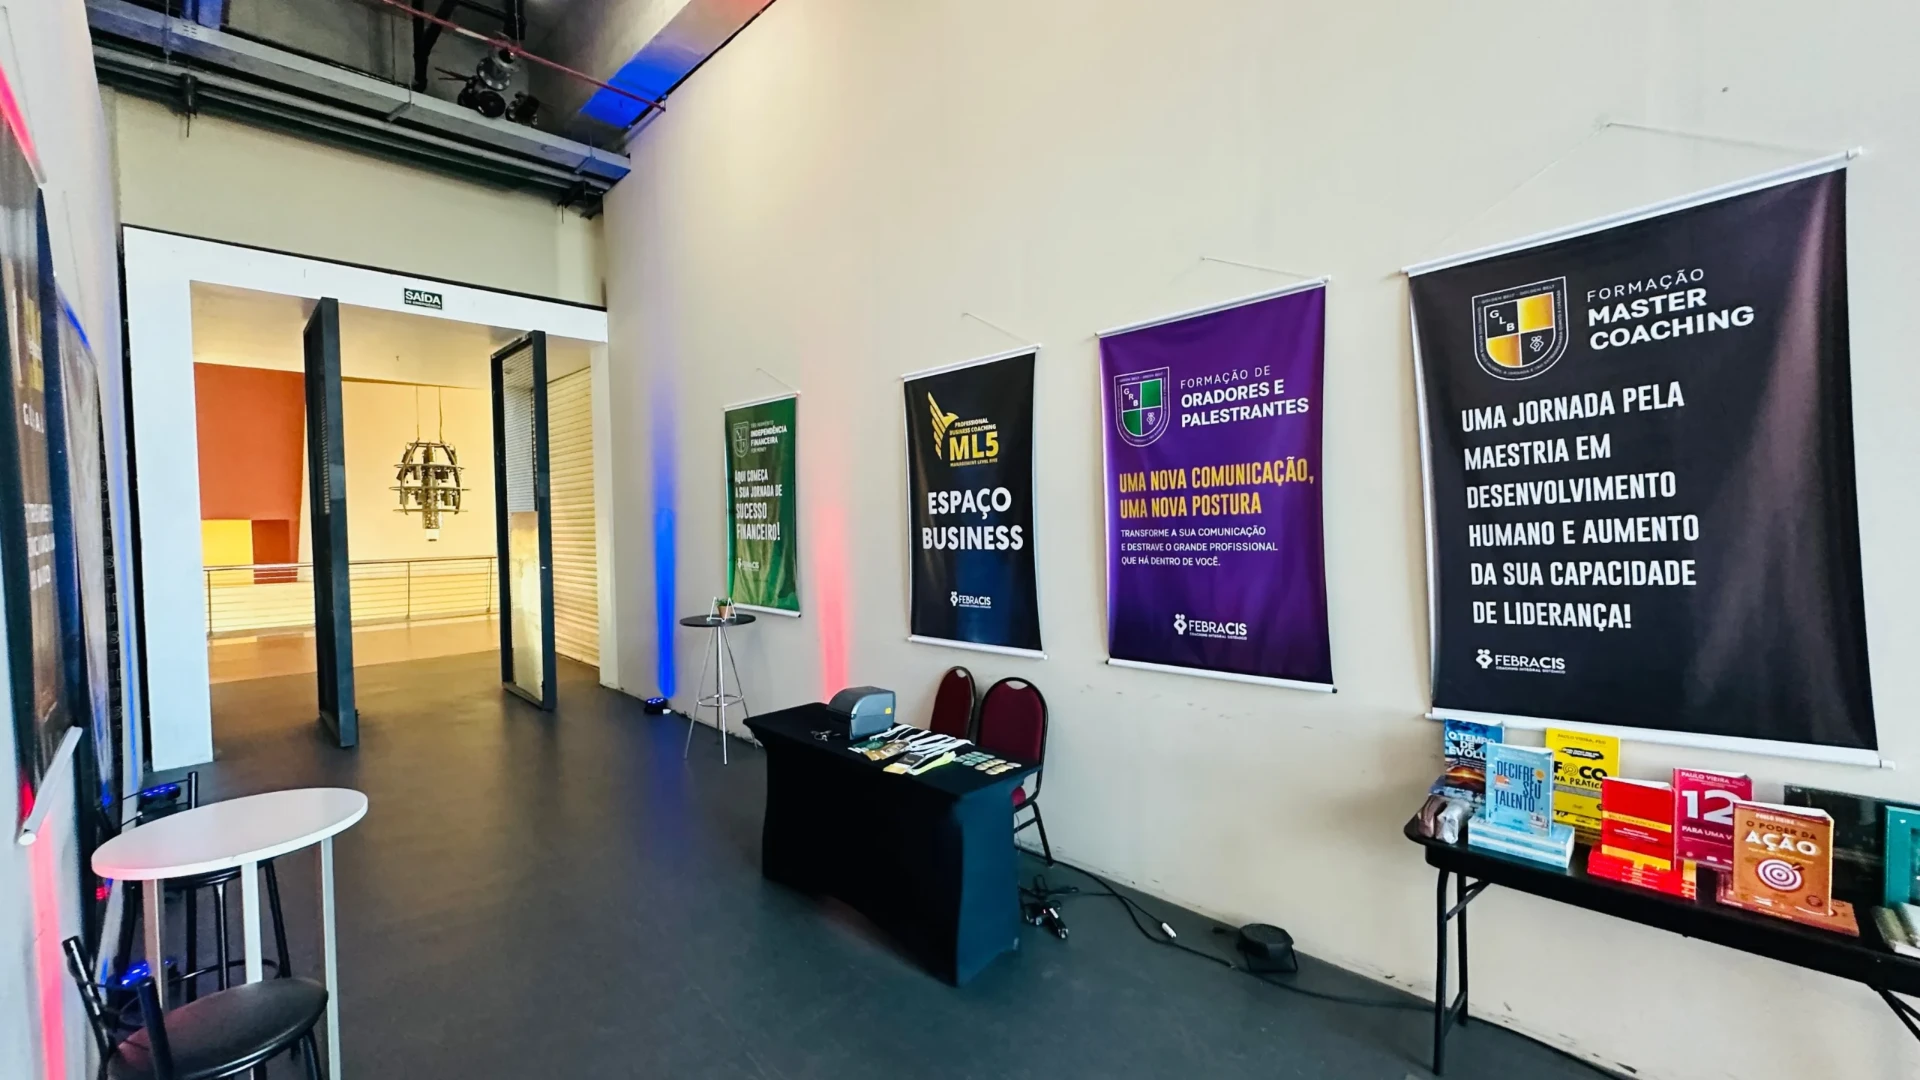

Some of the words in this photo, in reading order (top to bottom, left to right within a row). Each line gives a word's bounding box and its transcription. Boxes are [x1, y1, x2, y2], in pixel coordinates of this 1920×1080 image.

[1587, 268, 1705, 302] FORMAÇÃO
[405, 290, 441, 305] SAÍDA
[1588, 287, 1707, 327] MASTER
[1589, 306, 1755, 351] COACHING
[1180, 369, 1249, 390] FORMAÇÃO
[1255, 365, 1271, 377] DE
[1181, 381, 1270, 408] ORADORES
[1274, 379, 1285, 395] E
[1181, 397, 1310, 428] PALESTRANTES
[1461, 405, 1507, 432] UMA
[1512, 390, 1616, 427] JORNADA
[1622, 381, 1685, 414] PELA
[970, 423, 997, 433] COACHING
[750, 436, 778, 447] FINANCEIRA
[949, 430, 999, 462] ML5
[1464, 439, 1569, 471] MAESTRIA
[1576, 433, 1611, 461] EM
[735, 469, 747, 484] AQUI
[747, 468, 769, 483] COMEÇA
[1119, 471, 1147, 493] UMA
[1150, 468, 1187, 491] NOVA
[1191, 456, 1314, 489] COMUNICAÇÃO,
[739, 486, 750, 498] SUA
[750, 484, 774, 497] JORNADA
[775, 484, 783, 496] DE
[1466, 471, 1676, 509] DESENVOLVIMENTO
[736, 502, 767, 519] SUCESSO
[927, 486, 1012, 520] ESPAÇO
[1120, 498, 1148, 519] UMA
[1151, 496, 1188, 518] NOVA
[1192, 492, 1263, 517] POSTURA
[736, 521, 780, 541] FINANCEIRO!
[922, 524, 1024, 551] BUSINESS
[1121, 528, 1170, 538] TRANSFORME
[1171, 528, 1178, 537] A
[1179, 528, 1197, 537] SUA
[1198, 525, 1266, 538] COMUNICAÇÃO
[1468, 520, 1555, 547] HUMANO
[1562, 520, 1576, 545] E
[1582, 514, 1700, 544] AUMENTO
[1121, 543, 1126, 551] E
[1127, 543, 1165, 551] DESTRAVE
[1165, 543, 1172, 551] O
[1173, 542, 1208, 551] GRANDE
[1209, 542, 1279, 551] PROFISSIONAL
[1121, 556, 1137, 566] QUE
[1138, 555, 1149, 565] HÁ
[1150, 556, 1181, 566] DENTRO
[1182, 557, 1194, 566] DE
[1195, 556, 1221, 567] VOCÊ.
[1470, 562, 1497, 586] DA
[1503, 562, 1544, 586] SUA
[1550, 560, 1697, 586] CAPACIDADE
[958, 594, 992, 606] FEBRACIS
[1188, 620, 1248, 636] FEBRACIS
[1472, 601, 1498, 624] DE
[1503, 601, 1632, 632] LIDERANÇA!
[1494, 654, 1566, 670] FEBRACIS
[1448, 731, 1458, 740] O
[1460, 740, 1475, 751] DE
[1496, 760, 1535, 785] DECIFRE
[1681, 771, 1705, 780] PAULO
[1705, 774, 1730, 784] VIEIRA
[1494, 789, 1536, 813] TALENTO
[1523, 780, 1542, 800] SEU
[1681, 789, 1743, 826] 12
[1681, 825, 1704, 835] PARA
[1704, 829, 1725, 839] UMA
[1745, 829, 1817, 856] AÇÃO
[1758, 823, 1797, 836] PODER
[1801, 831, 1817, 840] DA
